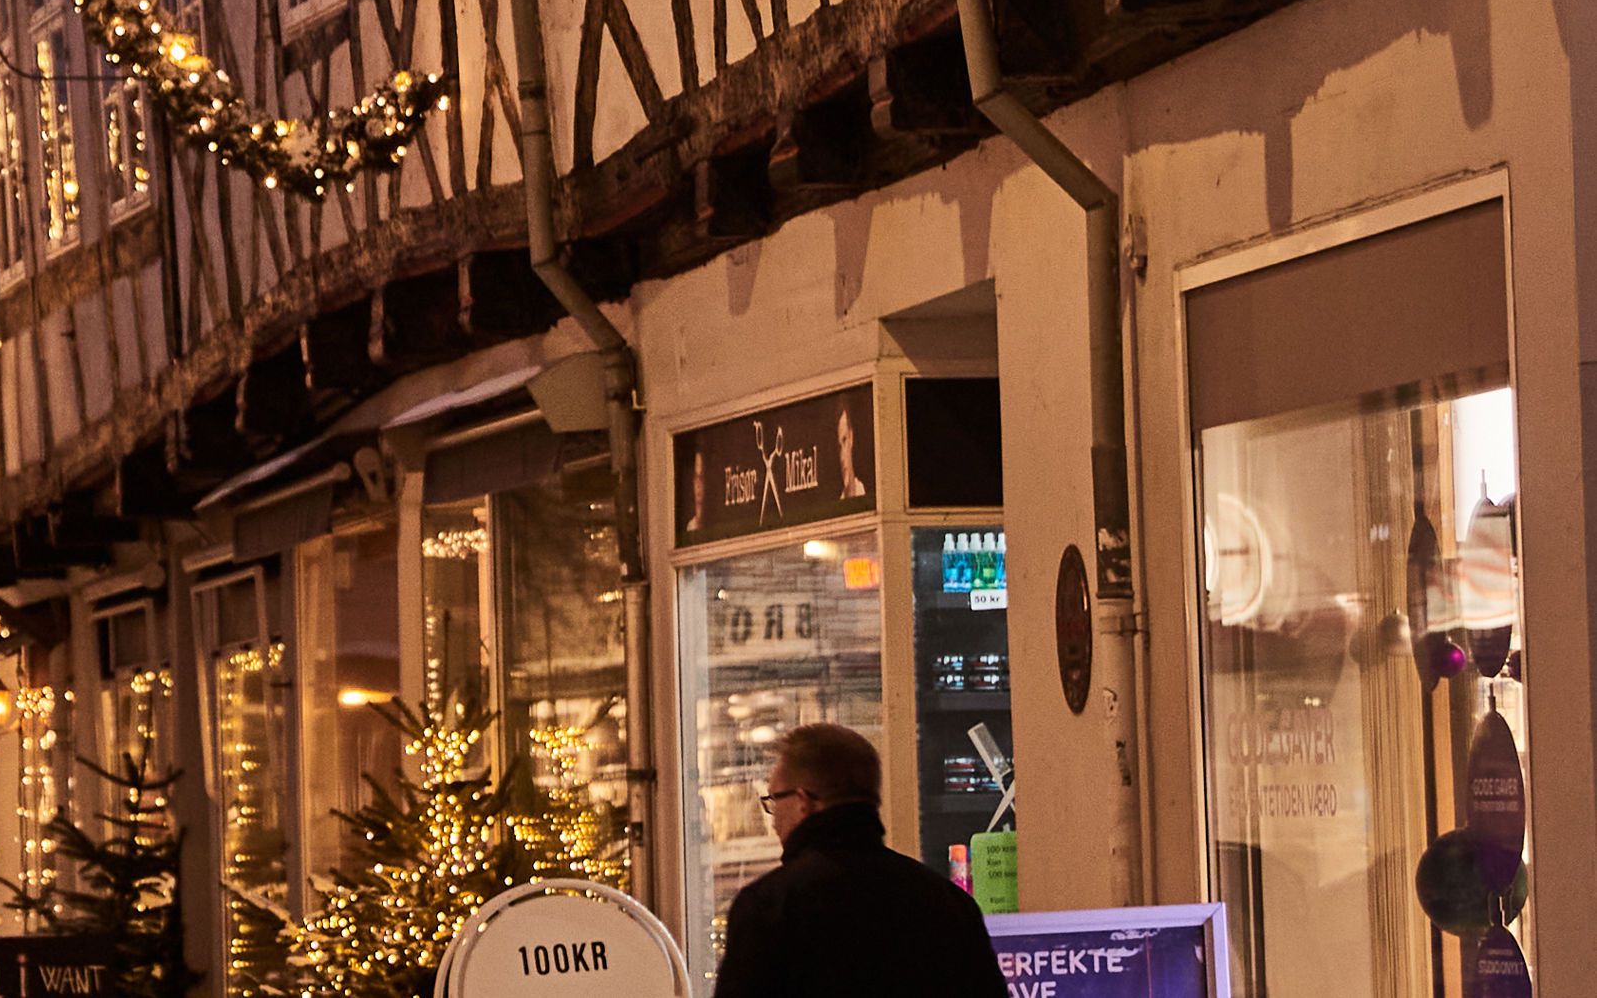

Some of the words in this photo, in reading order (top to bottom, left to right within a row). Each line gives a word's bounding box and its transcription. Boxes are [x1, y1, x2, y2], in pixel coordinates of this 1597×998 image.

[725, 465, 757, 506] Frisør
[784, 445, 819, 493] Mikal
[974, 595, 986, 603] 50
[989, 595, 1000, 603] kr
[1243, 784, 1305, 817] NTETIDEN
[1306, 783, 1338, 817] VÆRD
[518, 941, 608, 975] 100KR
[998, 946, 1124, 978] ERFEKTE
[38, 964, 106, 994] WANT
[1008, 981, 1057, 998] AVE
